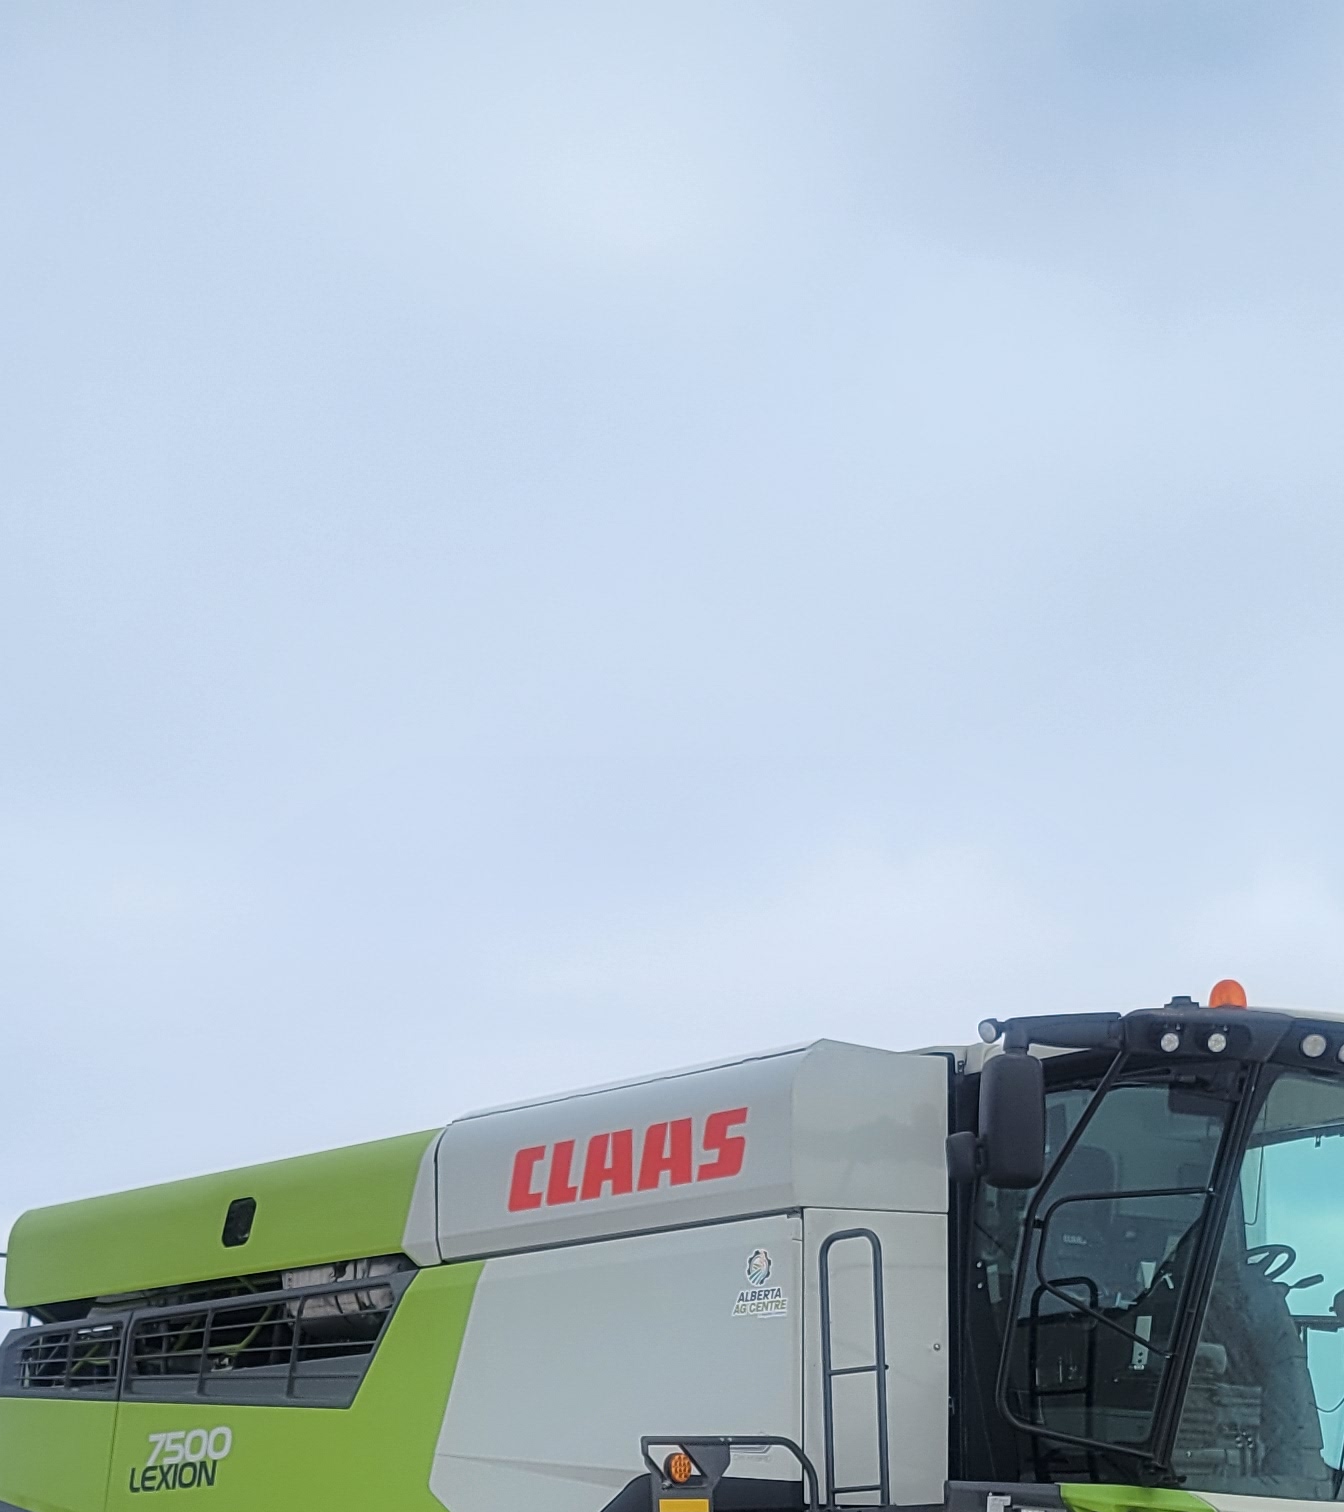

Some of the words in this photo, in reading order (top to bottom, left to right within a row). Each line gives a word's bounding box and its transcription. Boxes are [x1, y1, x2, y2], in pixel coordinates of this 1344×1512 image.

[508, 1107, 748, 1212] CLAAS
[733, 1303, 747, 1315] AG
[749, 1299, 787, 1313] CENTRE
[737, 1287, 782, 1303] ALBERTA
[146, 1426, 232, 1466] 7500
[129, 1459, 217, 1493] LEXION
